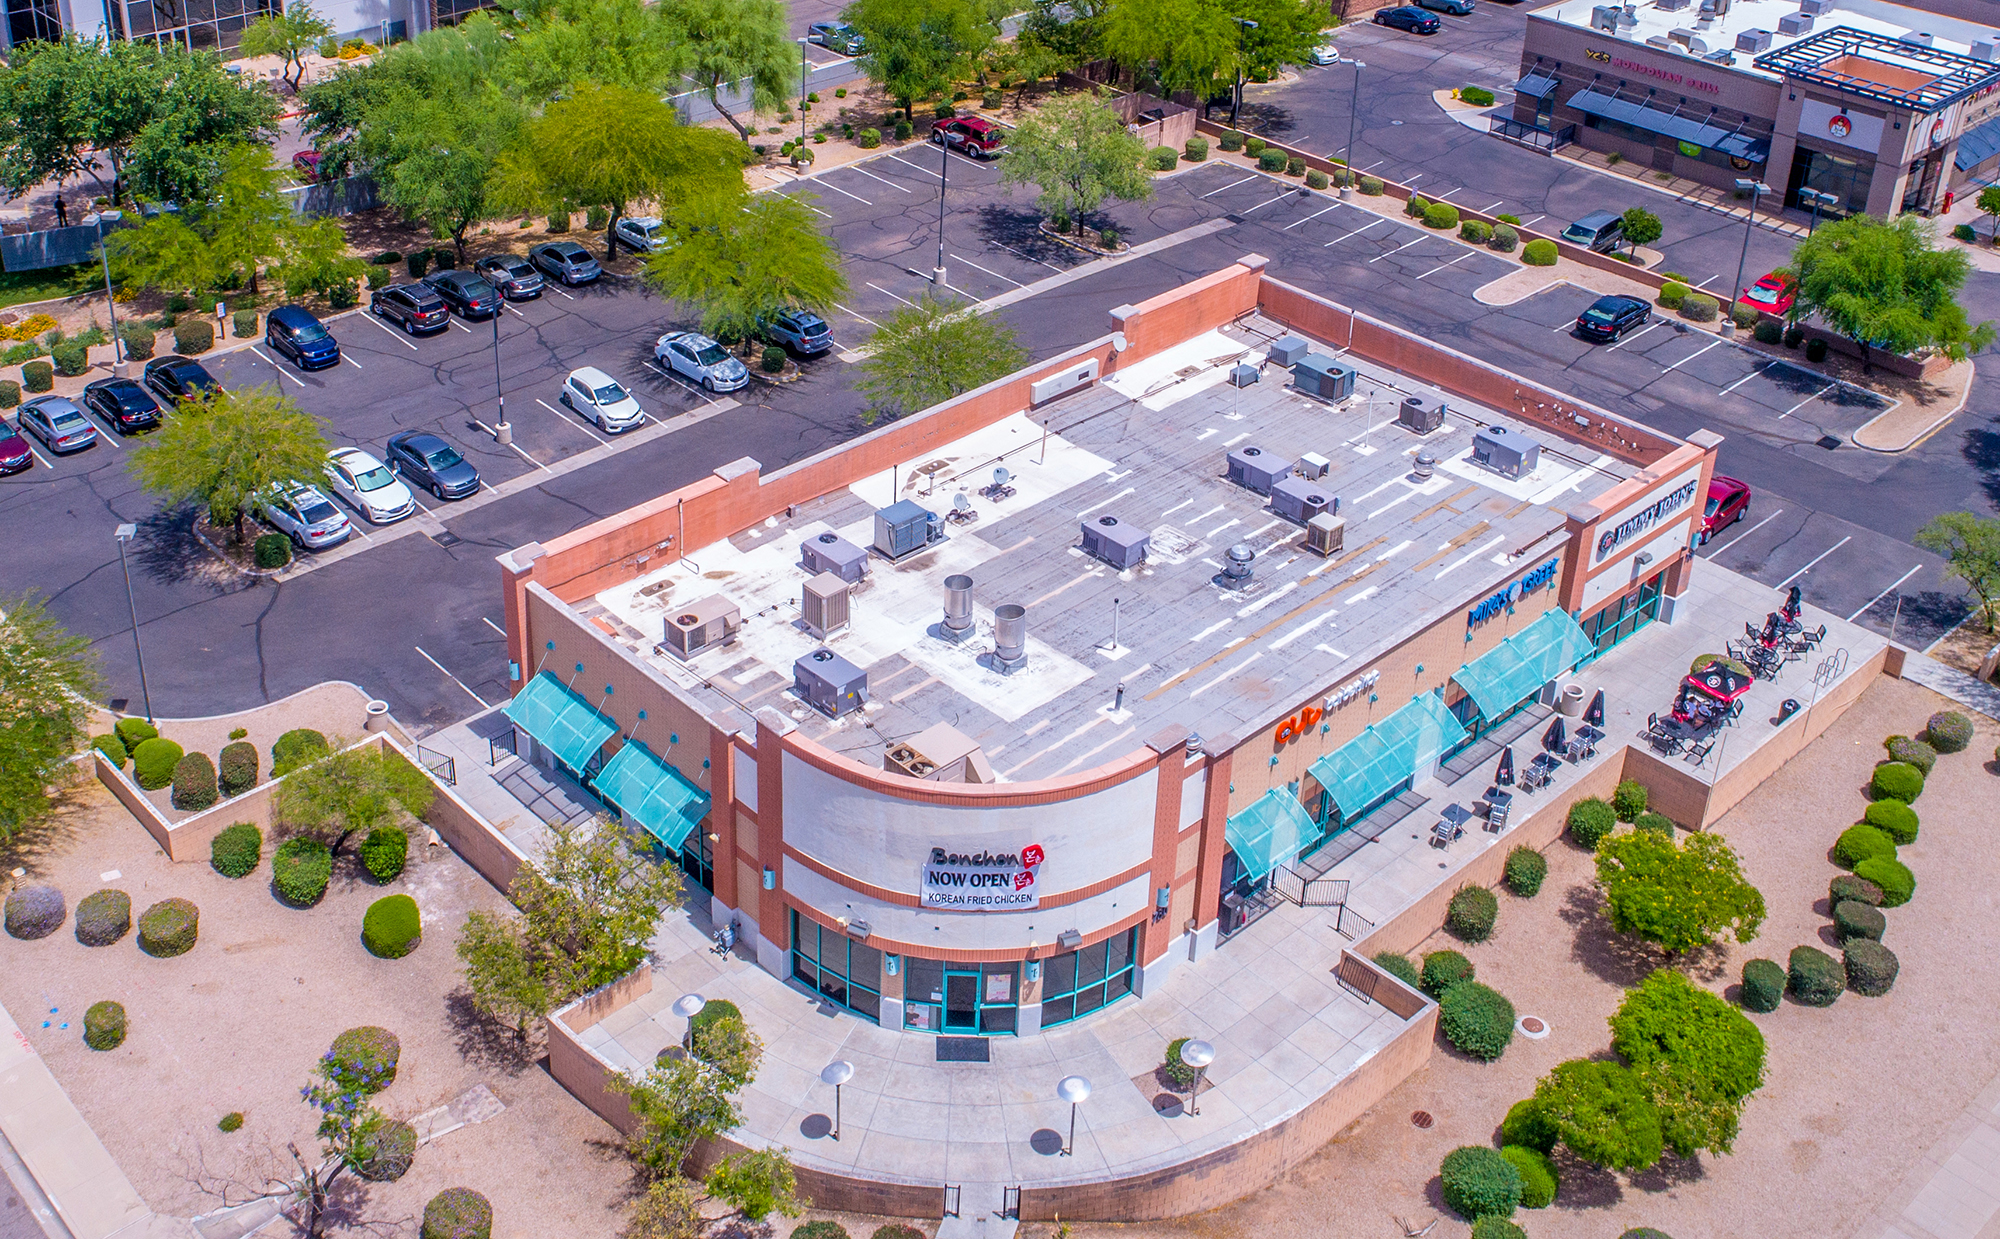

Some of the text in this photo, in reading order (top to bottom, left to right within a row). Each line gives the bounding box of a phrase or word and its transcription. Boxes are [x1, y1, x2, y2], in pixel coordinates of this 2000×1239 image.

[1586, 48, 1719, 94] YC'S MONGOLIAN GRILL
[1615, 503, 1658, 544] JIMMY
[1655, 479, 1698, 520] JOHN'S
[1522, 557, 1560, 593] GREEK
[931, 847, 1019, 866] Bonchon
[929, 871, 1010, 887] NOW OPEN
[928, 893, 1033, 905] KOREAN FRIED CHICKEN
